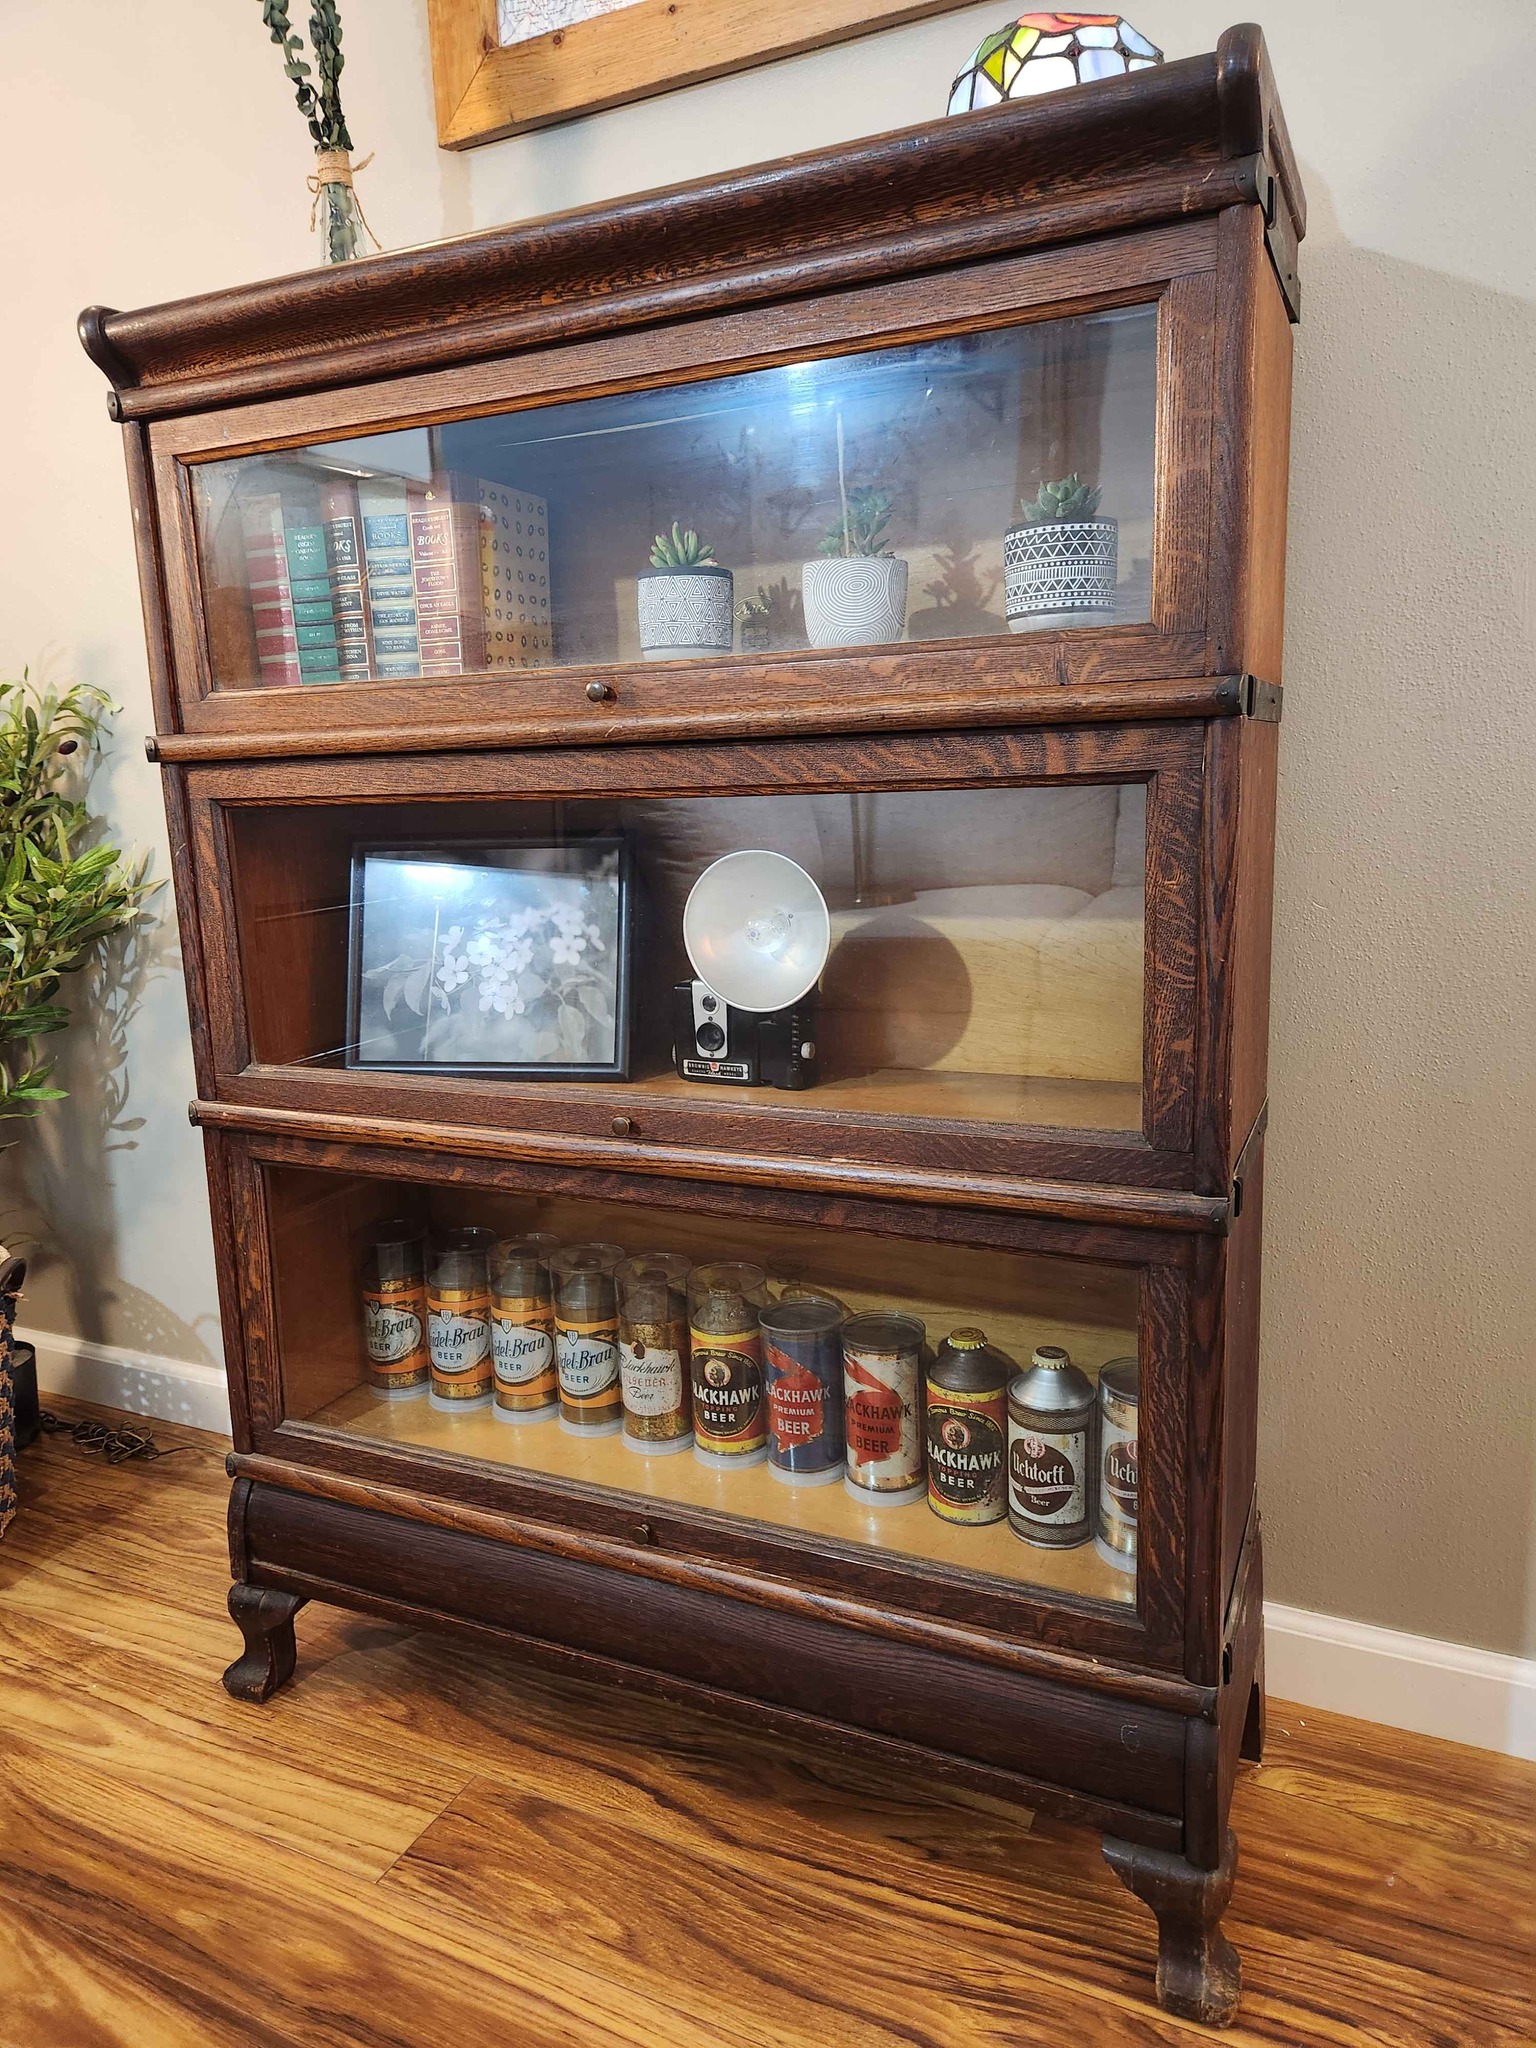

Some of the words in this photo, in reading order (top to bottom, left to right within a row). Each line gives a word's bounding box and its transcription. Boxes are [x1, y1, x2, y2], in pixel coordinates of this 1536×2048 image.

[417, 533, 449, 546] BOOKS
[370, 1341, 391, 1351] BEER
[438, 1351, 463, 1361] BEER
[498, 1361, 522, 1372] BEER
[564, 1373, 590, 1384] BEER
[704, 1410, 736, 1422] BEER
[773, 1403, 815, 1416] PREMIUM
[777, 1417, 811, 1435] BEER
[851, 1418, 895, 1434] PREMIUM
[856, 1435, 890, 1453] BEER
[1012, 1450, 1065, 1485] Uchtorff
[940, 1472, 975, 1489] BEER
[1030, 1495, 1051, 1507] Beer
